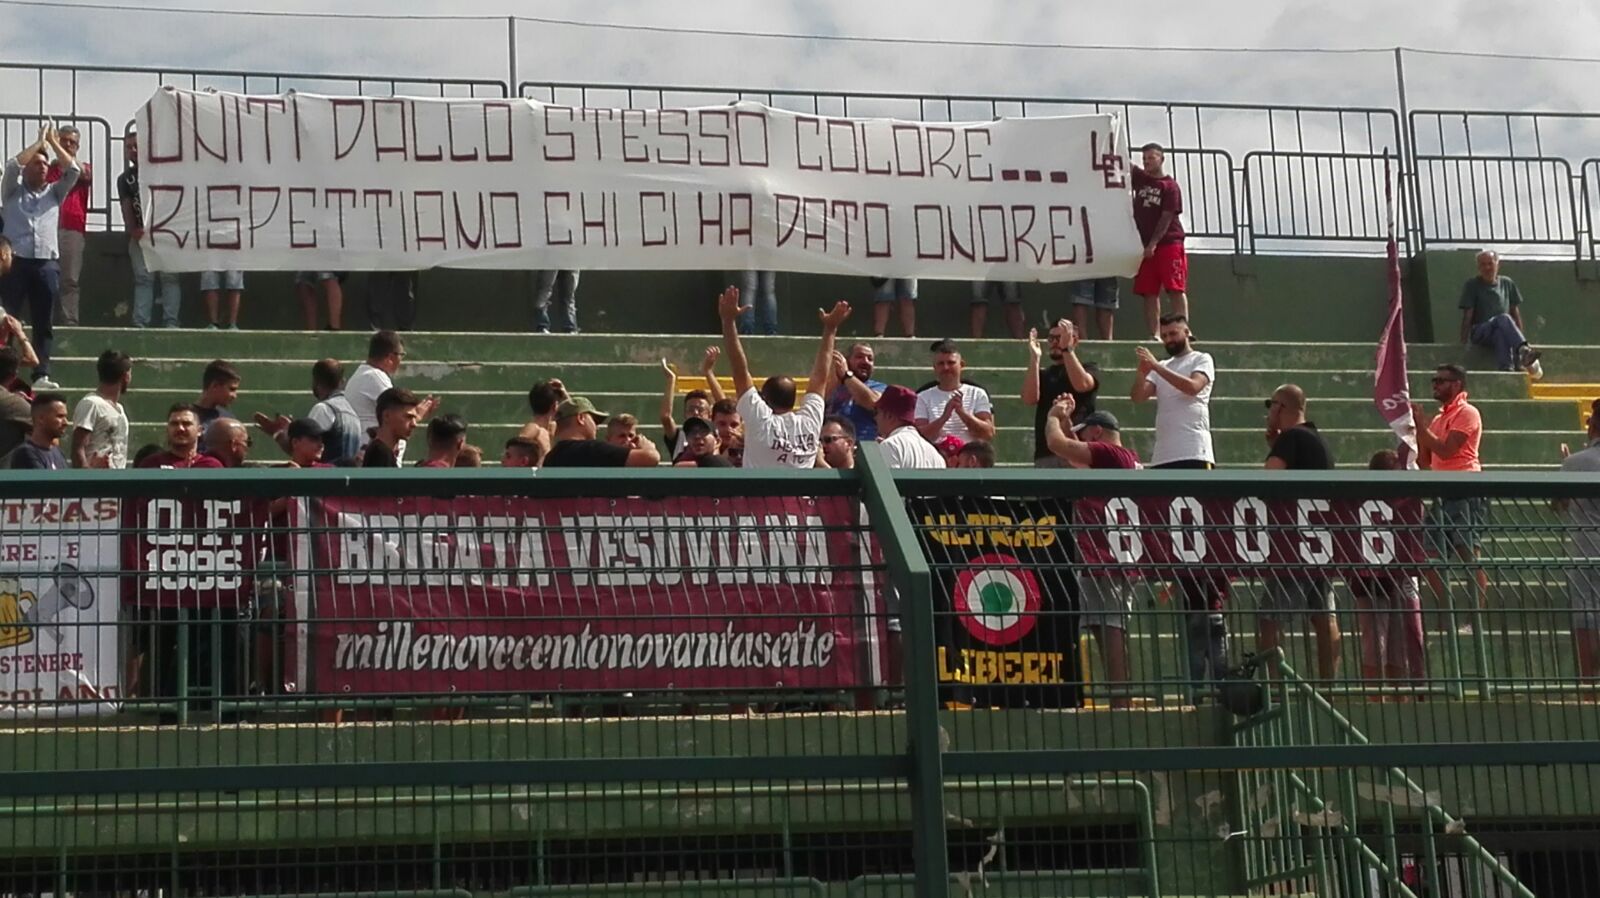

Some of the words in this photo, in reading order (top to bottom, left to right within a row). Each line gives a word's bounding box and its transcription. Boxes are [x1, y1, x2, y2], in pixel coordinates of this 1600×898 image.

[147, 92, 300, 164] UNITI
[333, 98, 514, 162] DALLO
[543, 105, 769, 168] STESSO
[148, 185, 523, 252] RISPETTIAMO
[543, 191, 619, 248] CHI
[639, 191, 678, 247] CI
[699, 191, 754, 247] HA
[773, 192, 893, 258] DATO
[914, 205, 1094, 266] ONORE!
[337, 512, 550, 587] BRIGATA
[561, 514, 833, 586] VESUVIANA
[924, 513, 1057, 547] ULTRAS
[334, 620, 836, 670] millenovecentonovantasette
[938, 646, 1065, 684] LIBERI
